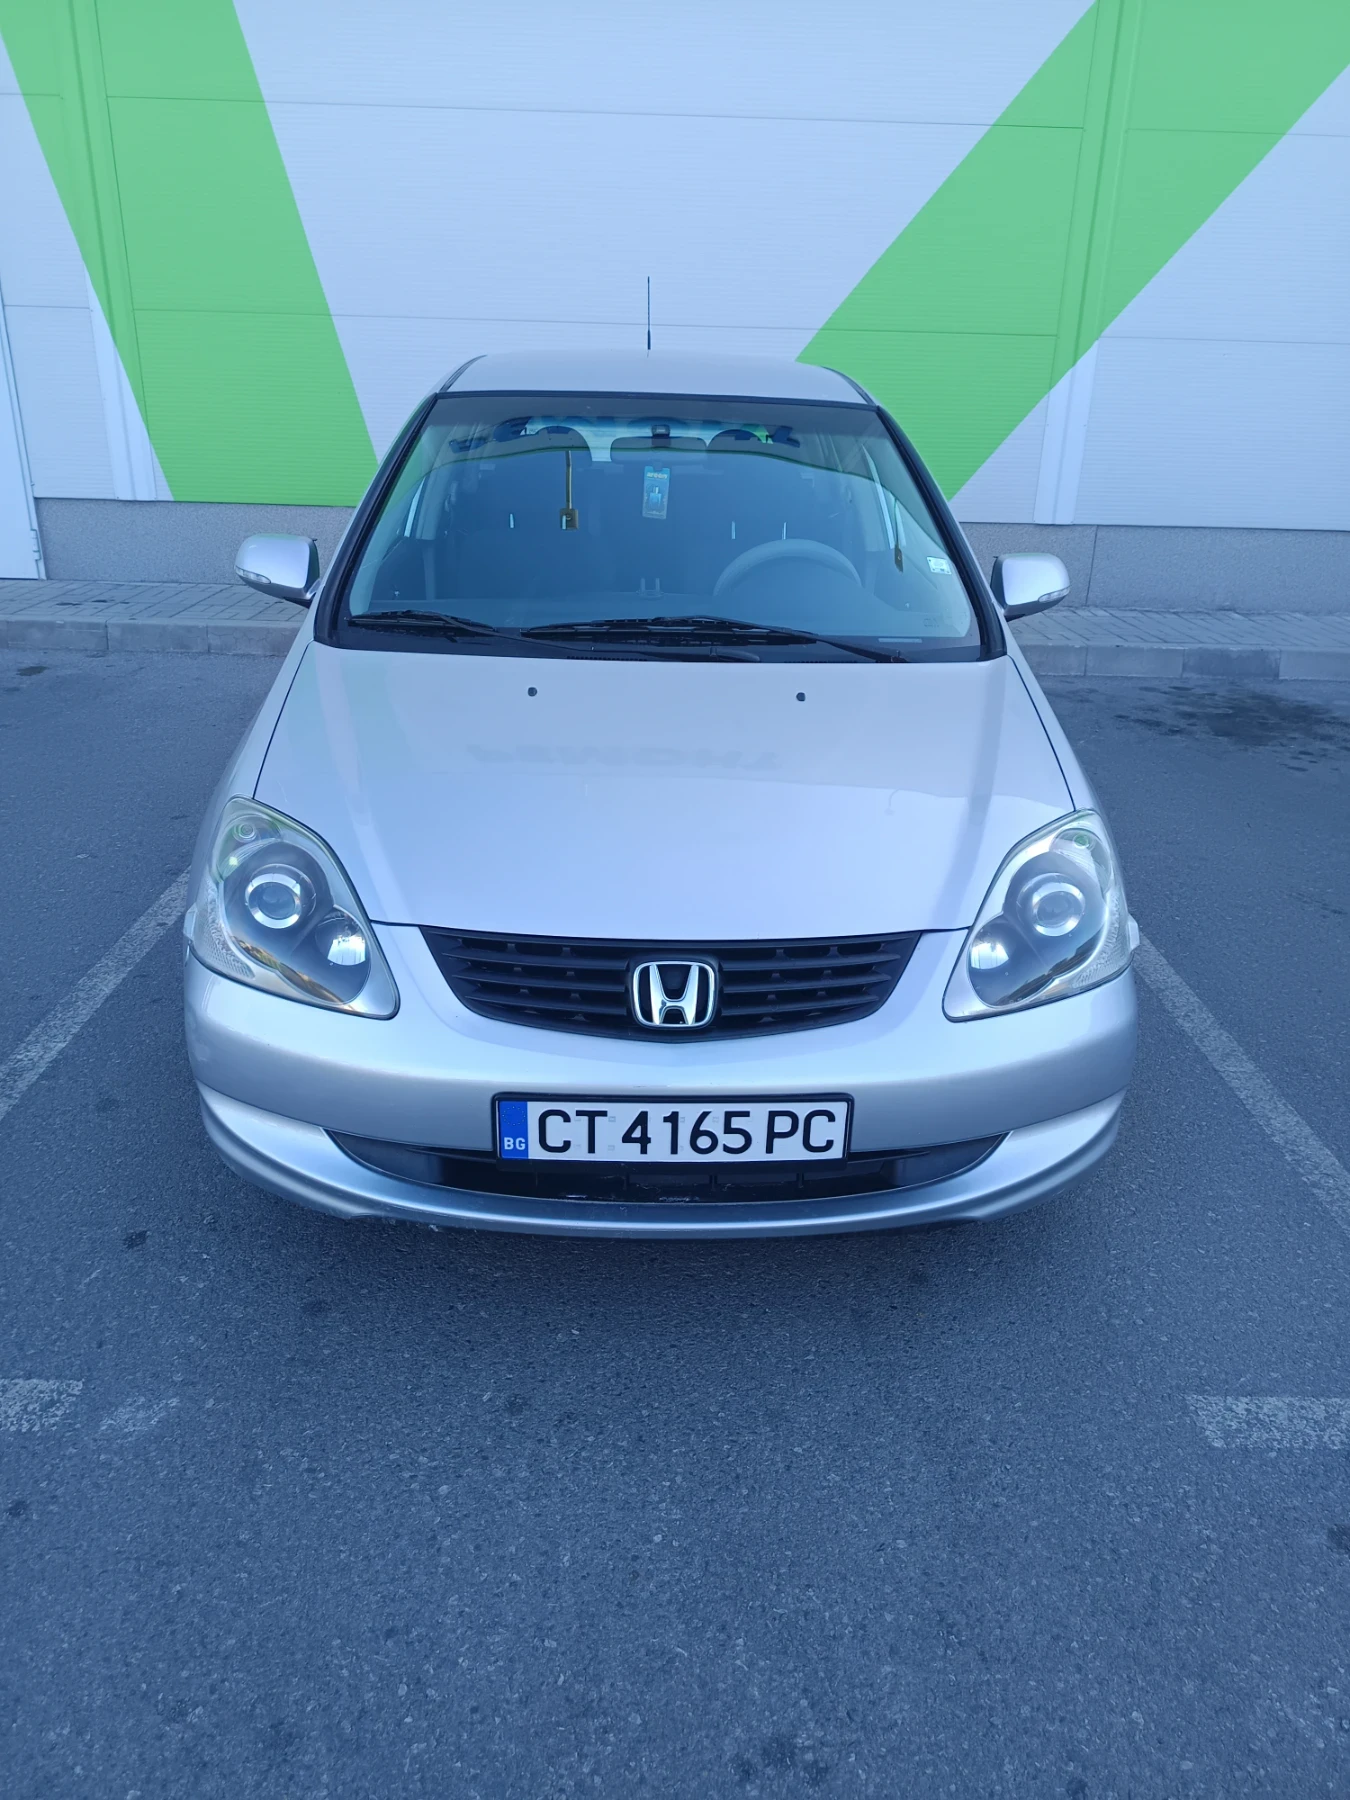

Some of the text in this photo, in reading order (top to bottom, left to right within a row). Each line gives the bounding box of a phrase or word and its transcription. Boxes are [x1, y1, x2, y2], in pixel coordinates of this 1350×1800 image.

[503, 1137, 526, 1150] BG
[538, 1109, 837, 1155] CT 4165 PC
